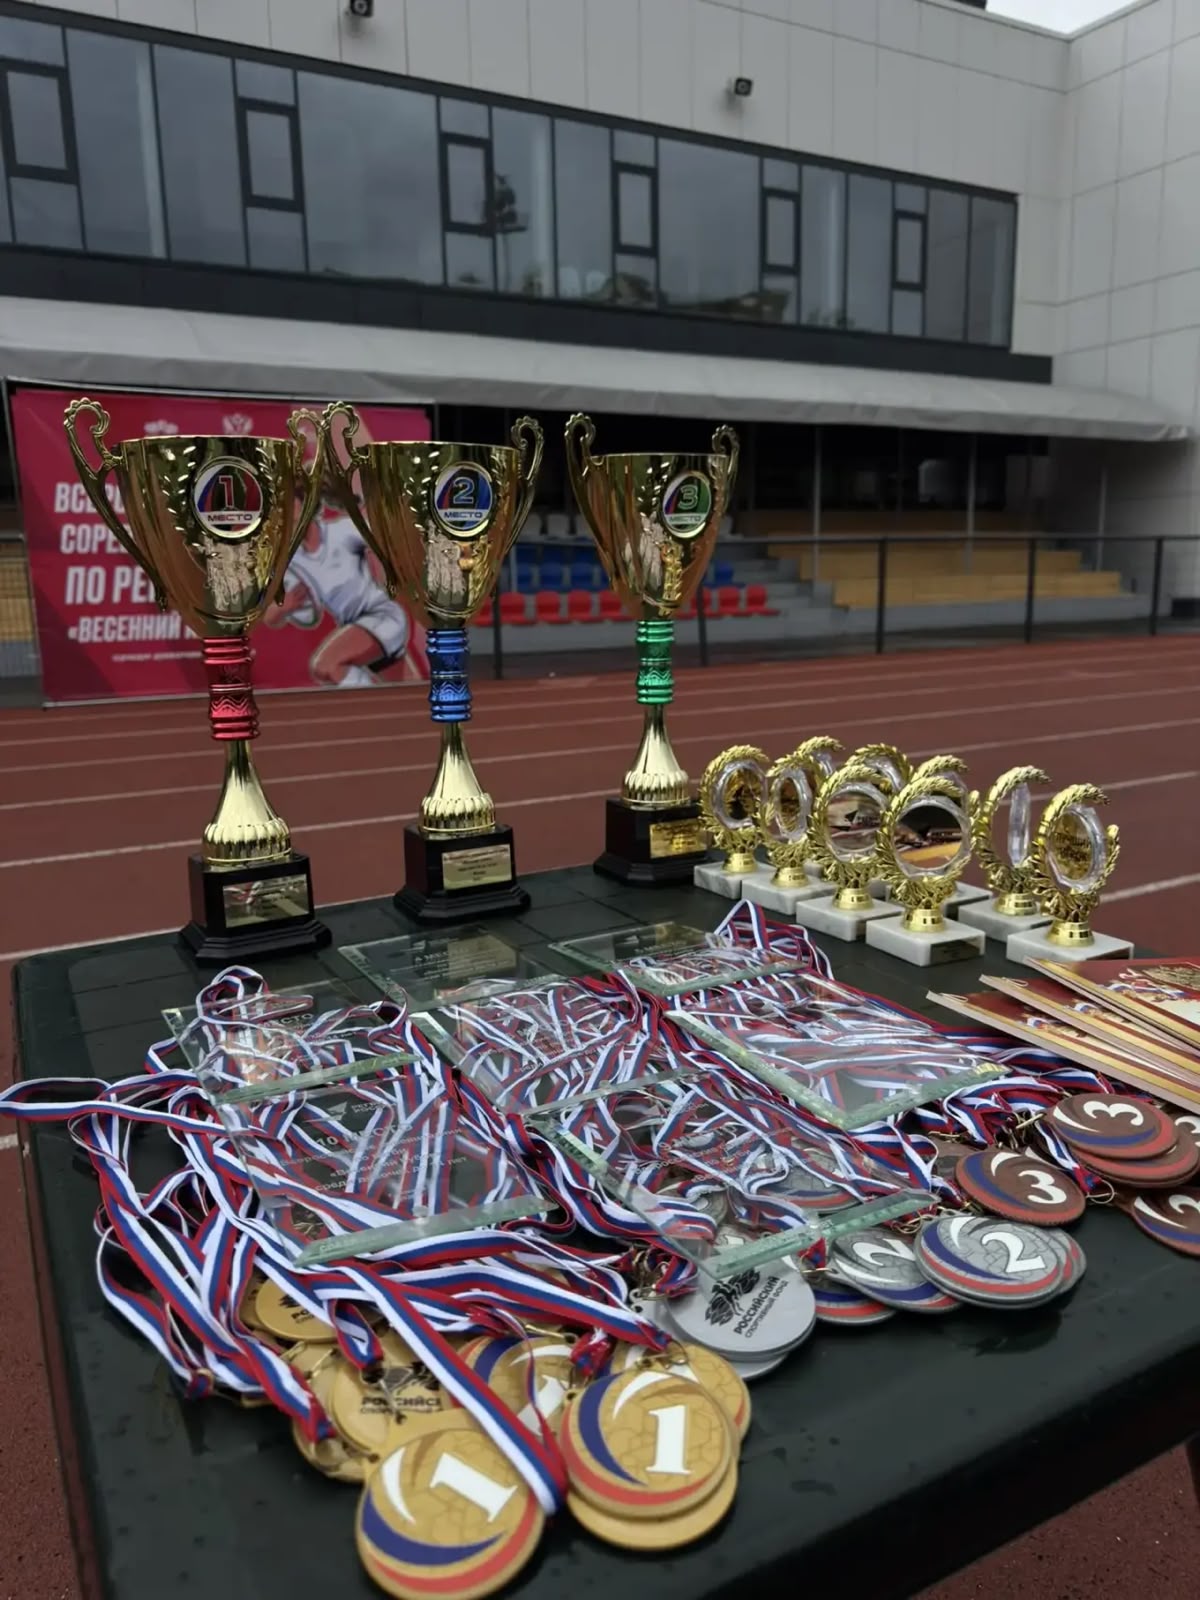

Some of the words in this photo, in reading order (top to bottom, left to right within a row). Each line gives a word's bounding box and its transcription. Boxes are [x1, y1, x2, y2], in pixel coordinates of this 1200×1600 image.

[218, 475, 234, 508] 1
[453, 477, 475, 504] 2
[678, 484, 698, 510] 3
[207, 513, 253, 522] МЕСТО
[443, 511, 483, 519] МЕСТО
[65, 565, 106, 604] ПО
[68, 610, 181, 643] «ВЕСЕННИЙ
[1083, 1101, 1144, 1126] 3
[1018, 1170, 1067, 1204] 3
[982, 1231, 1046, 1273] 2
[734, 1276, 780, 1335] РОССИЙСКИЙ
[645, 1404, 691, 1475] 1
[429, 1452, 518, 1523] 1
